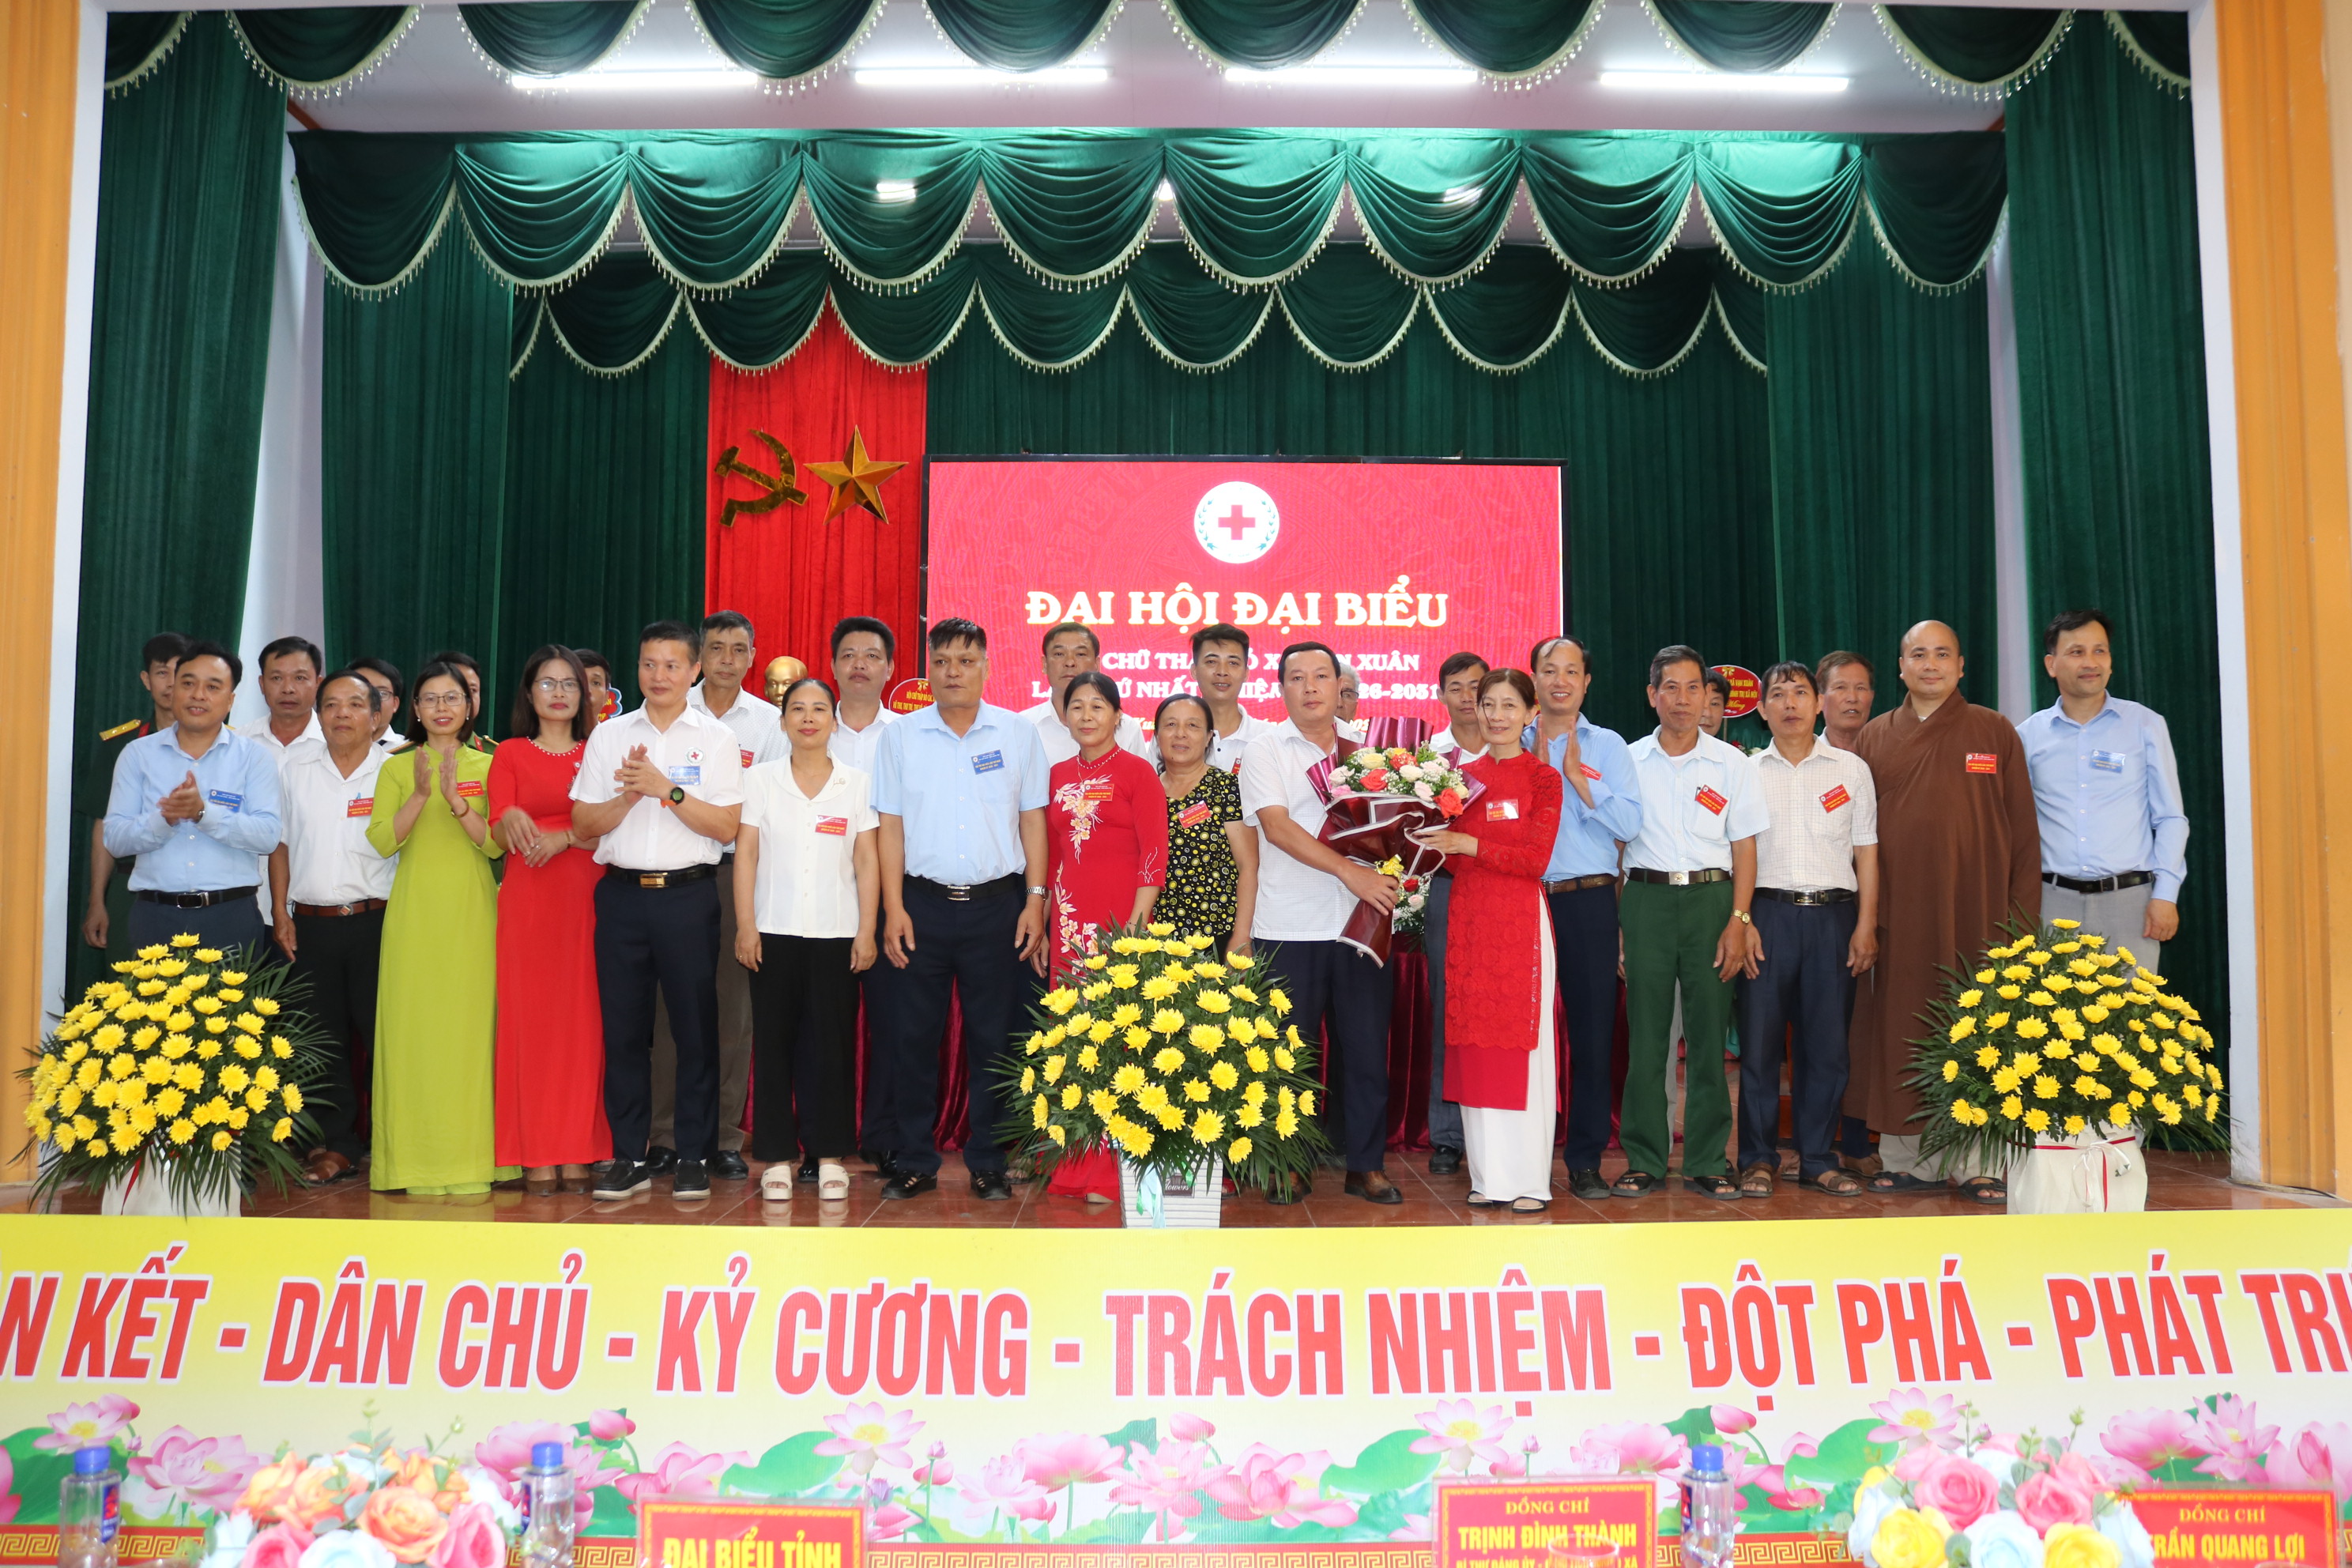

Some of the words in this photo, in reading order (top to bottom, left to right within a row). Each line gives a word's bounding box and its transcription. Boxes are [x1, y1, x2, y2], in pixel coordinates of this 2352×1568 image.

[1128, 582, 1219, 634] HỘI
[1231, 591, 1321, 635] ĐẠI
[1334, 575, 1449, 628] BIỂU
[1102, 648, 1151, 669] CHỮ
[1154, 652, 1194, 669] TH
[1246, 646, 1259, 670] Ỏ
[1263, 653, 1281, 670] X
[1356, 650, 1420, 671] XUÂN
[1136, 674, 1199, 699] NHẤT
[1358, 682, 1438, 700] 26-2031
[61, 1246, 209, 1379] KẾT
[263, 1261, 423, 1385] DÂN
[439, 1253, 588, 1390] CHỦ
[657, 1255, 756, 1392] KỶ
[775, 1283, 1027, 1396] CƯƠNG
[1106, 1272, 1344, 1396] TRÁCH
[1369, 1268, 1611, 1417] NHIỆM
[1682, 1264, 1815, 1412] ĐỘT
[1837, 1259, 1992, 1384] PHÁ
[2047, 1253, 2234, 1378] PHÁT
[2241, 1273, 2352, 1373] TRI
[1505, 1496, 1555, 1515] ĐỒNG
[1559, 1496, 1590, 1514] CHÍ
[2179, 1502, 2230, 1523] ĐỒNG
[2234, 1505, 2266, 1523] CHÍ
[714, 1525, 775, 1568] BIỂU
[781, 1529, 842, 1568] TỈNH
[1458, 1525, 1516, 1555] TRỊNH
[1521, 1521, 1569, 1549] ĐÌNH
[1574, 1520, 1637, 1547] THÀNH
[2150, 1525, 2196, 1559] RẦN
[2201, 1533, 2269, 1562] QUANG
[2274, 1532, 2305, 1565] LỢI
